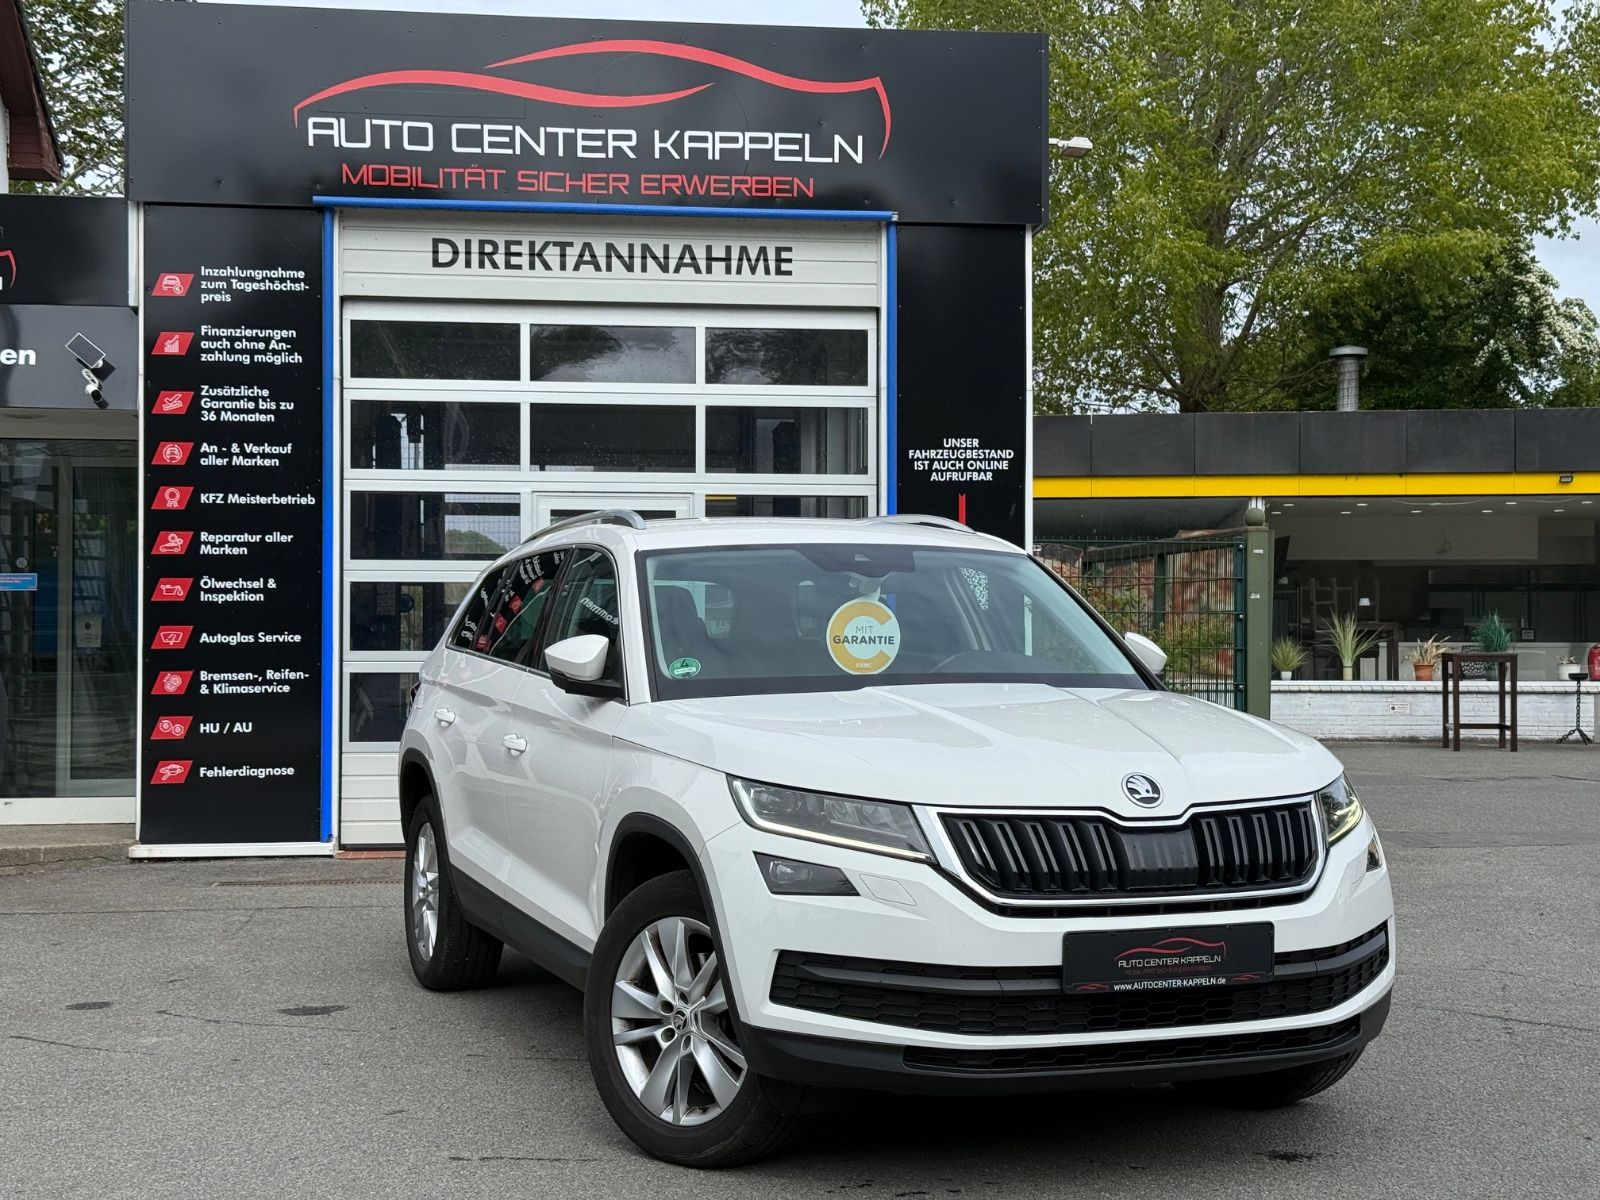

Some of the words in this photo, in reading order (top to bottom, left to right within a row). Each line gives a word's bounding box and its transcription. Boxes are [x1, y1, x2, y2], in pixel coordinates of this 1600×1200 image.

[308, 117, 434, 152] AUTO
[451, 123, 637, 159] CENTER
[654, 130, 863, 164] KAPPELN
[342, 163, 506, 190] MOBILITÄT
[517, 170, 629, 195] SICHER
[640, 174, 814, 198] ERWERBEN
[432, 237, 793, 277] DIREKTANNAHME
[201, 266, 305, 280] Inzahlungnahme
[200, 281, 227, 289] zum
[231, 279, 310, 293] Tageshöchst-
[201, 291, 232, 304] preis
[201, 325, 296, 340] Finanzierungen
[200, 339, 231, 349] auch
[234, 339, 266, 350] ohne
[269, 339, 291, 350] An-
[200, 351, 250, 365] zahlung
[254, 352, 302, 365] möglich
[200, 385, 269, 397] Zusätzliche
[200, 398, 255, 409] Garantie
[259, 399, 276, 410] bis
[280, 402, 294, 410] zu
[200, 411, 217, 421] 36
[220, 411, 275, 422] Monaten
[231, 443, 240, 453] &
[244, 442, 292, 454] Verkauf
[943, 438, 979, 448] UNSER
[909, 449, 1014, 459] FAHRZEUGBESTAND
[200, 455, 229, 466] aller
[232, 455, 279, 466] Marken
[914, 461, 929, 470] IST
[932, 461, 964, 470] AUCH
[967, 461, 1009, 470] ONLINE
[930, 471, 993, 481] AUFRUFBAR
[200, 493, 224, 504] KFZ
[228, 493, 316, 505] Meisterbetrieb
[200, 532, 262, 544] Reparatur
[265, 532, 293, 542] aller
[200, 544, 248, 555] Marken
[200, 576, 263, 589] Ölwechsel
[267, 579, 276, 589] &
[200, 591, 265, 604] Inspektion
[855, 625, 874, 634] MIT
[199, 632, 255, 645] Autoglas
[258, 632, 302, 643] Service
[833, 635, 895, 645] GARANTIE
[200, 671, 262, 682] Bremsen-,
[266, 669, 309, 680] Reifen-
[200, 684, 210, 695] &
[213, 683, 291, 694] Klimaservice
[200, 723, 220, 734] HU
[223, 722, 230, 734] /
[233, 722, 253, 733] AU
[200, 766, 295, 778] Fehlerdiagnose
[1118, 959, 1144, 968] AUTO
[1144, 957, 1179, 967] CENTER
[1180, 955, 1221, 965] KAPPELN
[1113, 976, 1226, 991] www.AUTOCENTER-KAPPELN.de
